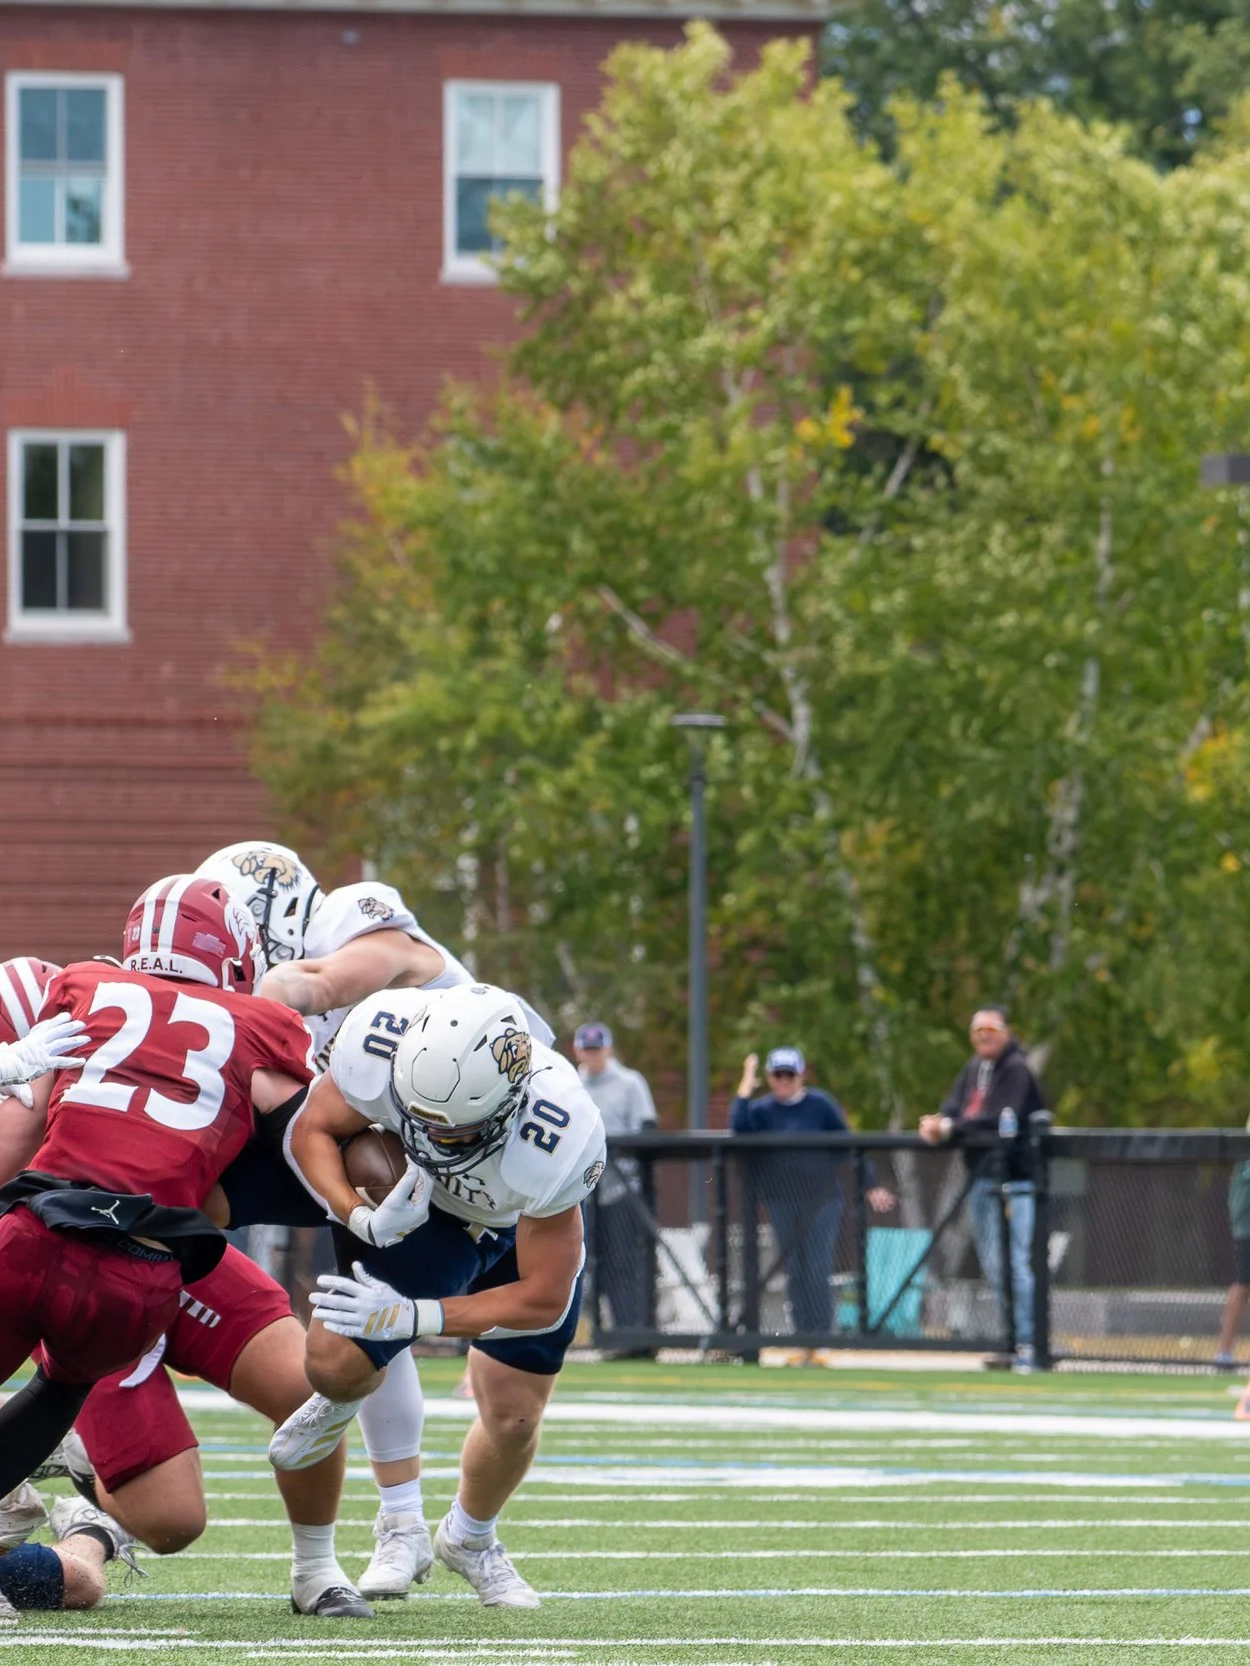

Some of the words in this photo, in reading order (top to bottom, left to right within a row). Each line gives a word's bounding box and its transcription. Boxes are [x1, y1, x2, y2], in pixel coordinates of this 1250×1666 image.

[130, 957, 184, 974] R.E.A.L.
[60, 981, 236, 1131] 23
[362, 1010, 410, 1061] 20
[519, 1098, 572, 1157] 20
